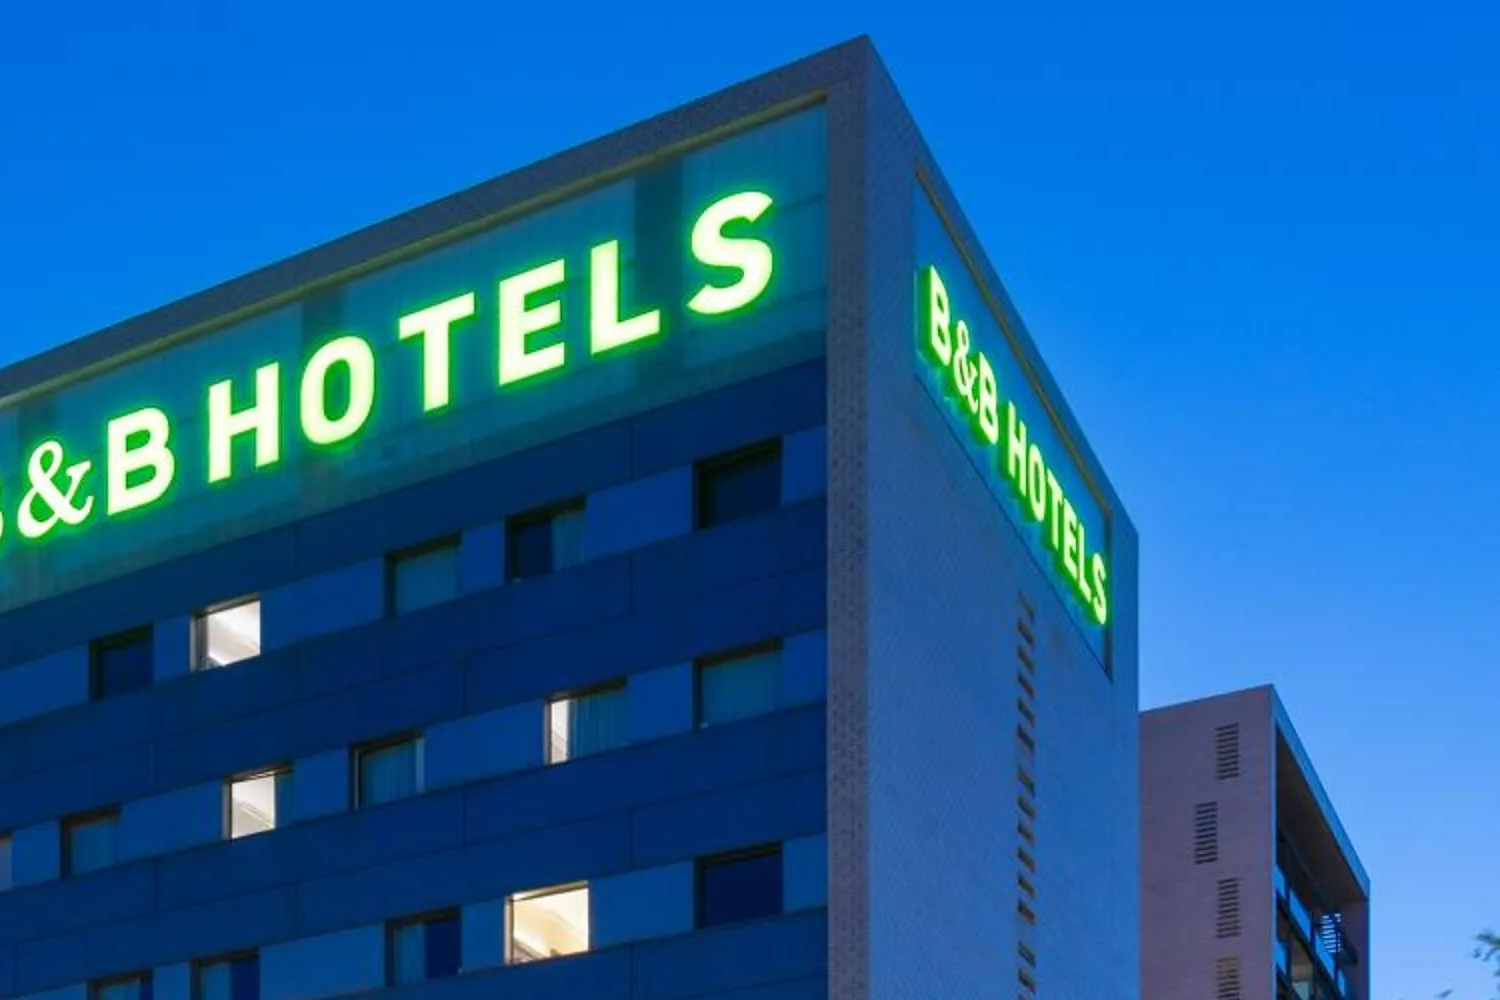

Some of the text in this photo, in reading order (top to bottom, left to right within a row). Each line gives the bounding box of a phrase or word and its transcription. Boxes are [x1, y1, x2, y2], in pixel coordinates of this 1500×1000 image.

[208, 190, 774, 483] HOTELS
[929, 265, 1107, 625] B&B HOTELS
